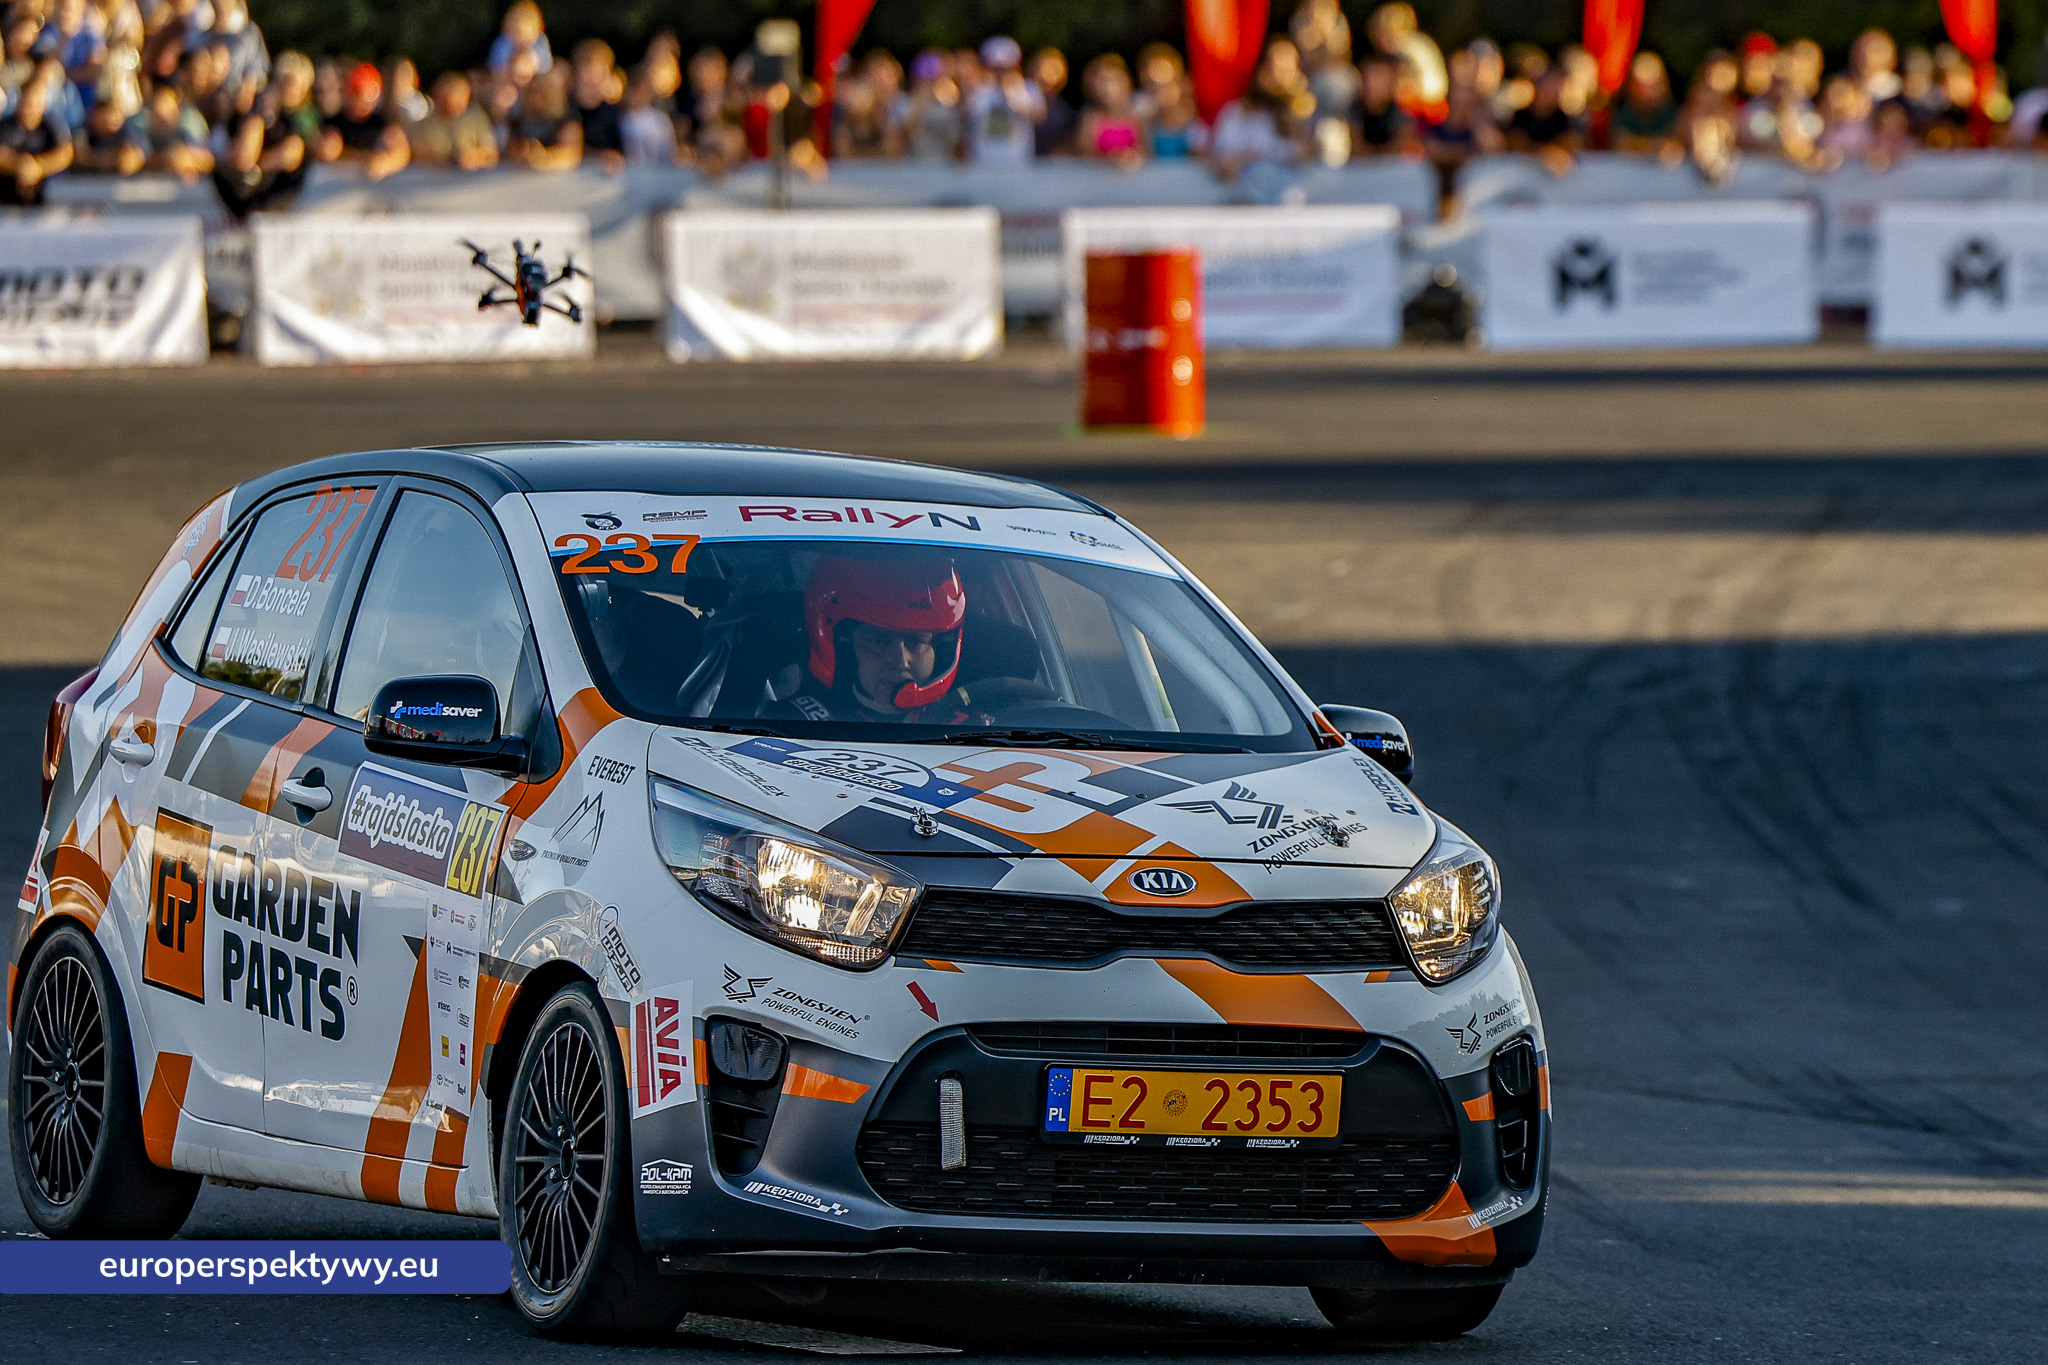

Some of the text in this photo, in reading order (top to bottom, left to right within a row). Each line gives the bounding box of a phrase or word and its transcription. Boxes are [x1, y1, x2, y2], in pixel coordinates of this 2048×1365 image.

[275, 483, 377, 582] 237
[554, 533, 701, 575] 237
[408, 702, 483, 718] medisaver
[1356, 735, 1408, 751] medisaver
[587, 754, 636, 786] EVEREST
[785, 758, 903, 791] #rajdslaska
[815, 752, 921, 777] 237
[349, 789, 503, 896] #rajdslaska 237
[1262, 835, 1326, 875] POWERFUL
[1140, 871, 1188, 890] KIA
[213, 844, 361, 968] GARDEN
[608, 926, 641, 985] MOTO
[760, 997, 860, 1039] POWERFUL ENGINES
[1048, 1107, 1067, 1122] PL
[1081, 1074, 1148, 1129] E2
[1201, 1078, 1325, 1133] 2353
[640, 1167, 692, 1181] POL-KAM
